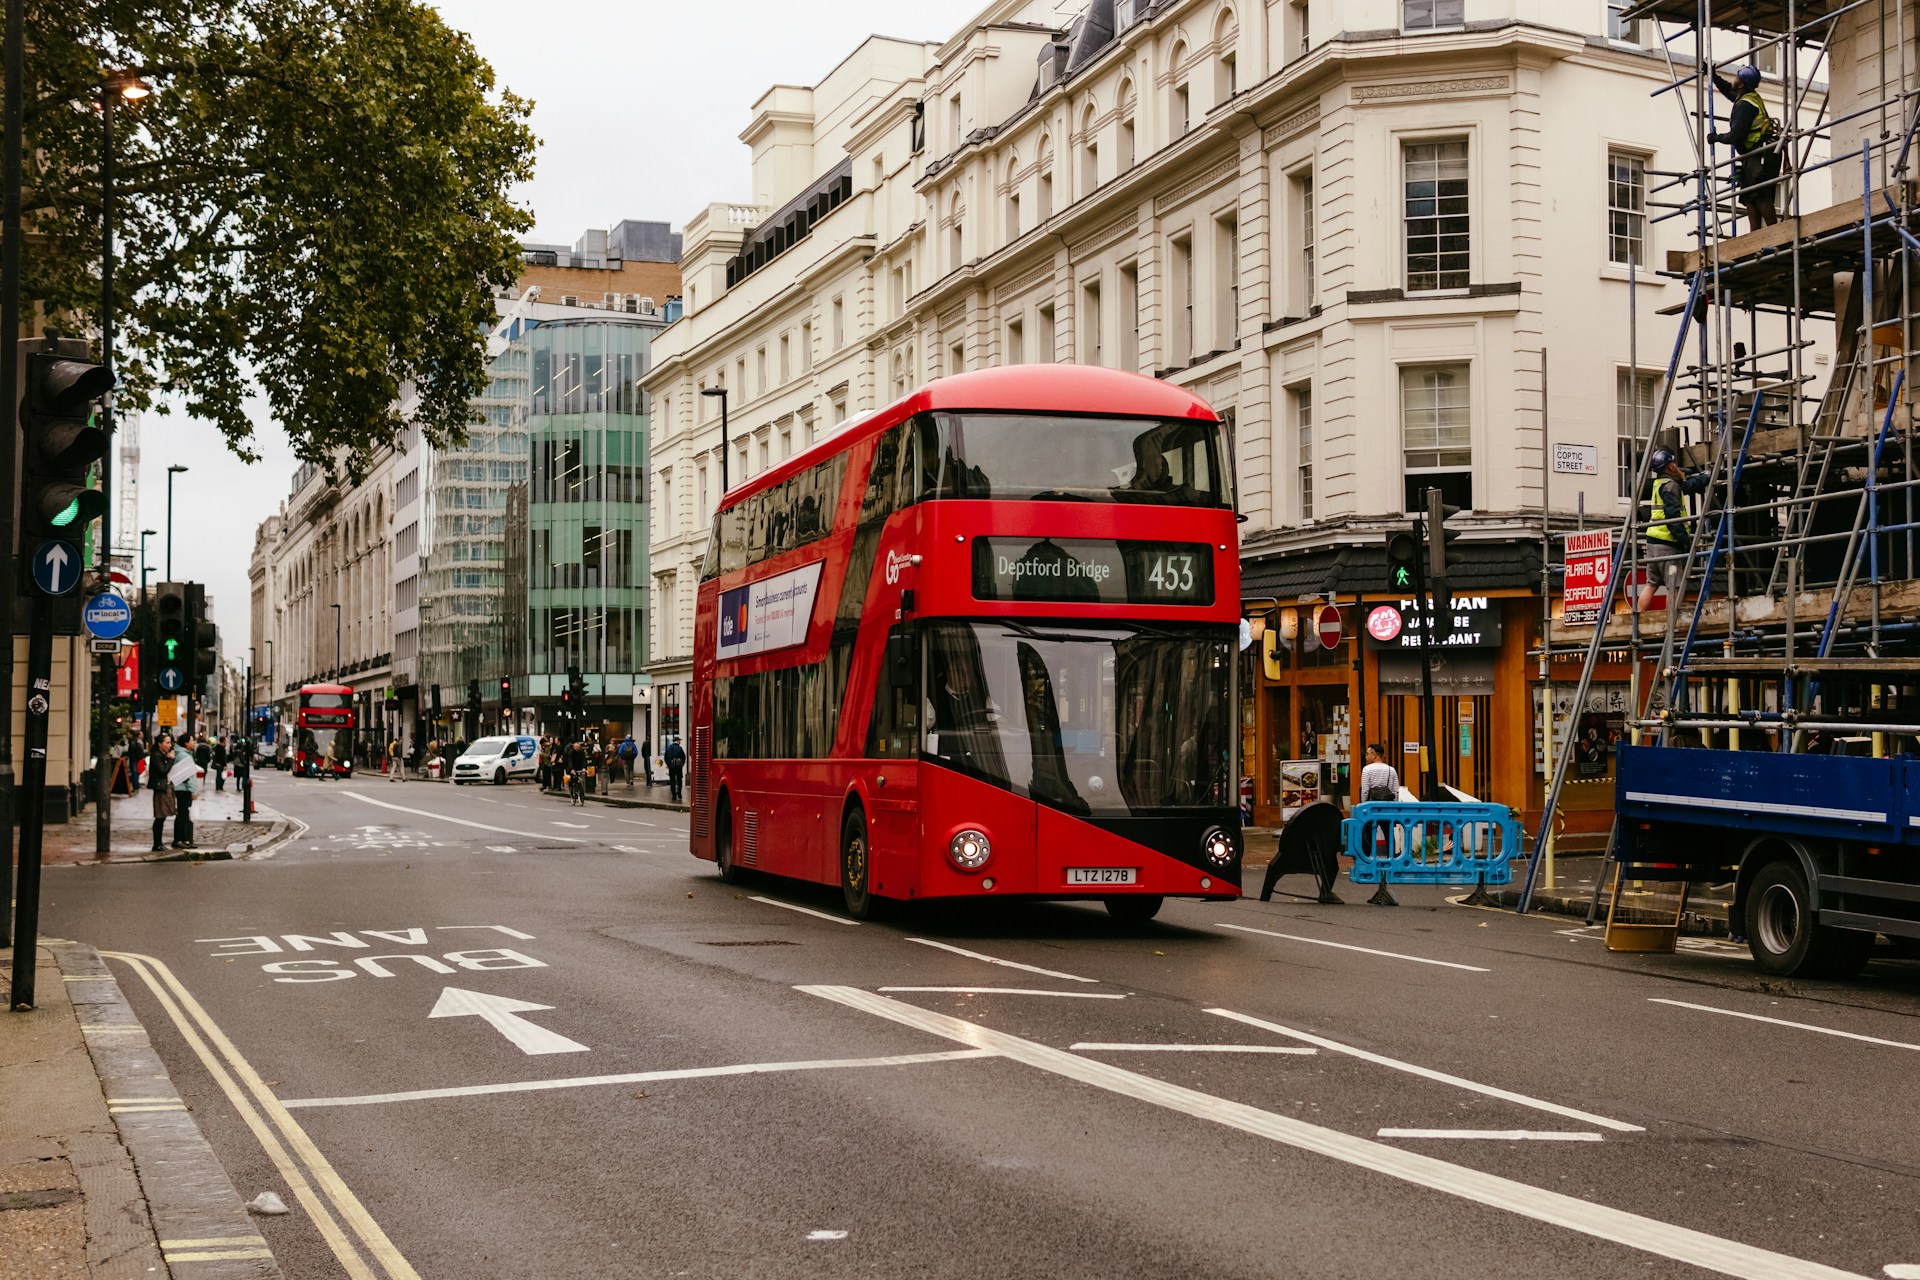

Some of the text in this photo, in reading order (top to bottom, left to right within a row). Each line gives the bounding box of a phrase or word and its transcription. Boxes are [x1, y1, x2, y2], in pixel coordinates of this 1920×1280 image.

[1557, 451, 1583, 461] COPTIC
[1557, 461, 1583, 470] STREET
[1567, 531, 1609, 551] WARNING
[886, 549, 899, 585] Go
[998, 556, 1110, 582] Deptford Bridge
[1148, 555, 1194, 591] 453
[1565, 562, 1593, 577] ALARMS
[1597, 561, 1606, 575] 4
[723, 615, 734, 637] tide
[1408, 616, 1470, 629] JAASE
[1401, 632, 1481, 647] RESRANT
[1074, 869, 1128, 882] LTZ 1278
[194, 925, 537, 957] LANE
[261, 948, 550, 984] BUS
